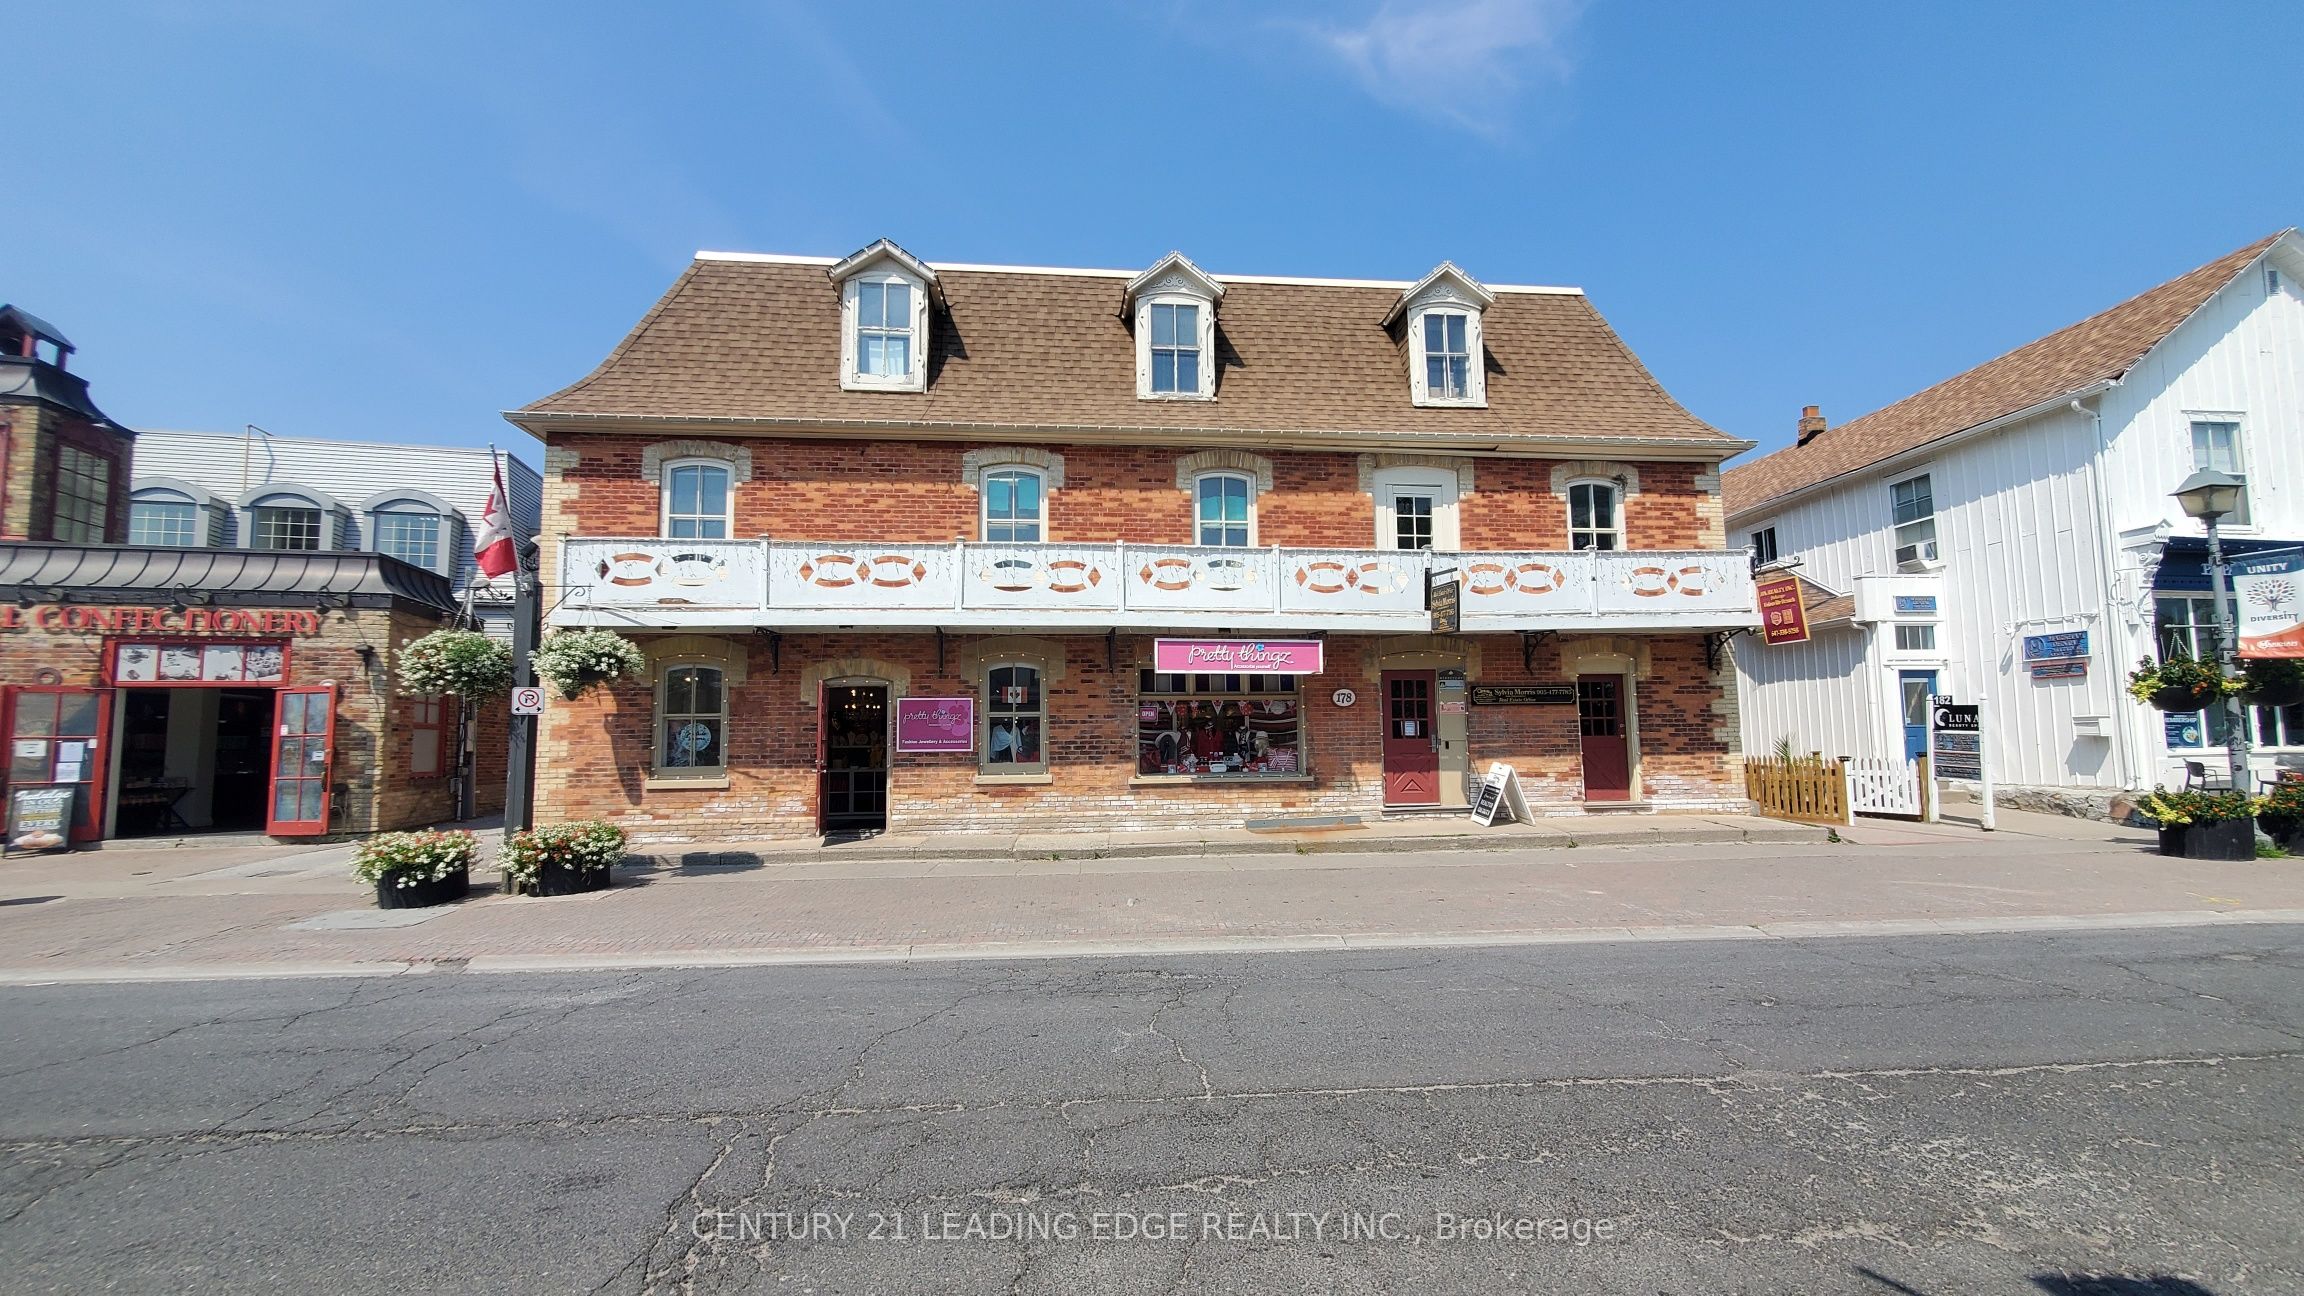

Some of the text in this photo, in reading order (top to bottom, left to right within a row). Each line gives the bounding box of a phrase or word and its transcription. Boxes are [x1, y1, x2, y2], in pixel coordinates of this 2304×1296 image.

[2247, 563, 2288, 574] UNITY
[36, 604, 321, 634] CONFECTIONERY
[2250, 611, 2299, 623] DIVERSITY
[1238, 642, 1294, 670] thingz
[1336, 692, 1352, 704] 178
[1934, 696, 1951, 705] 182
[903, 710, 929, 724] pretty
[1948, 714, 1978, 723] LUNA
